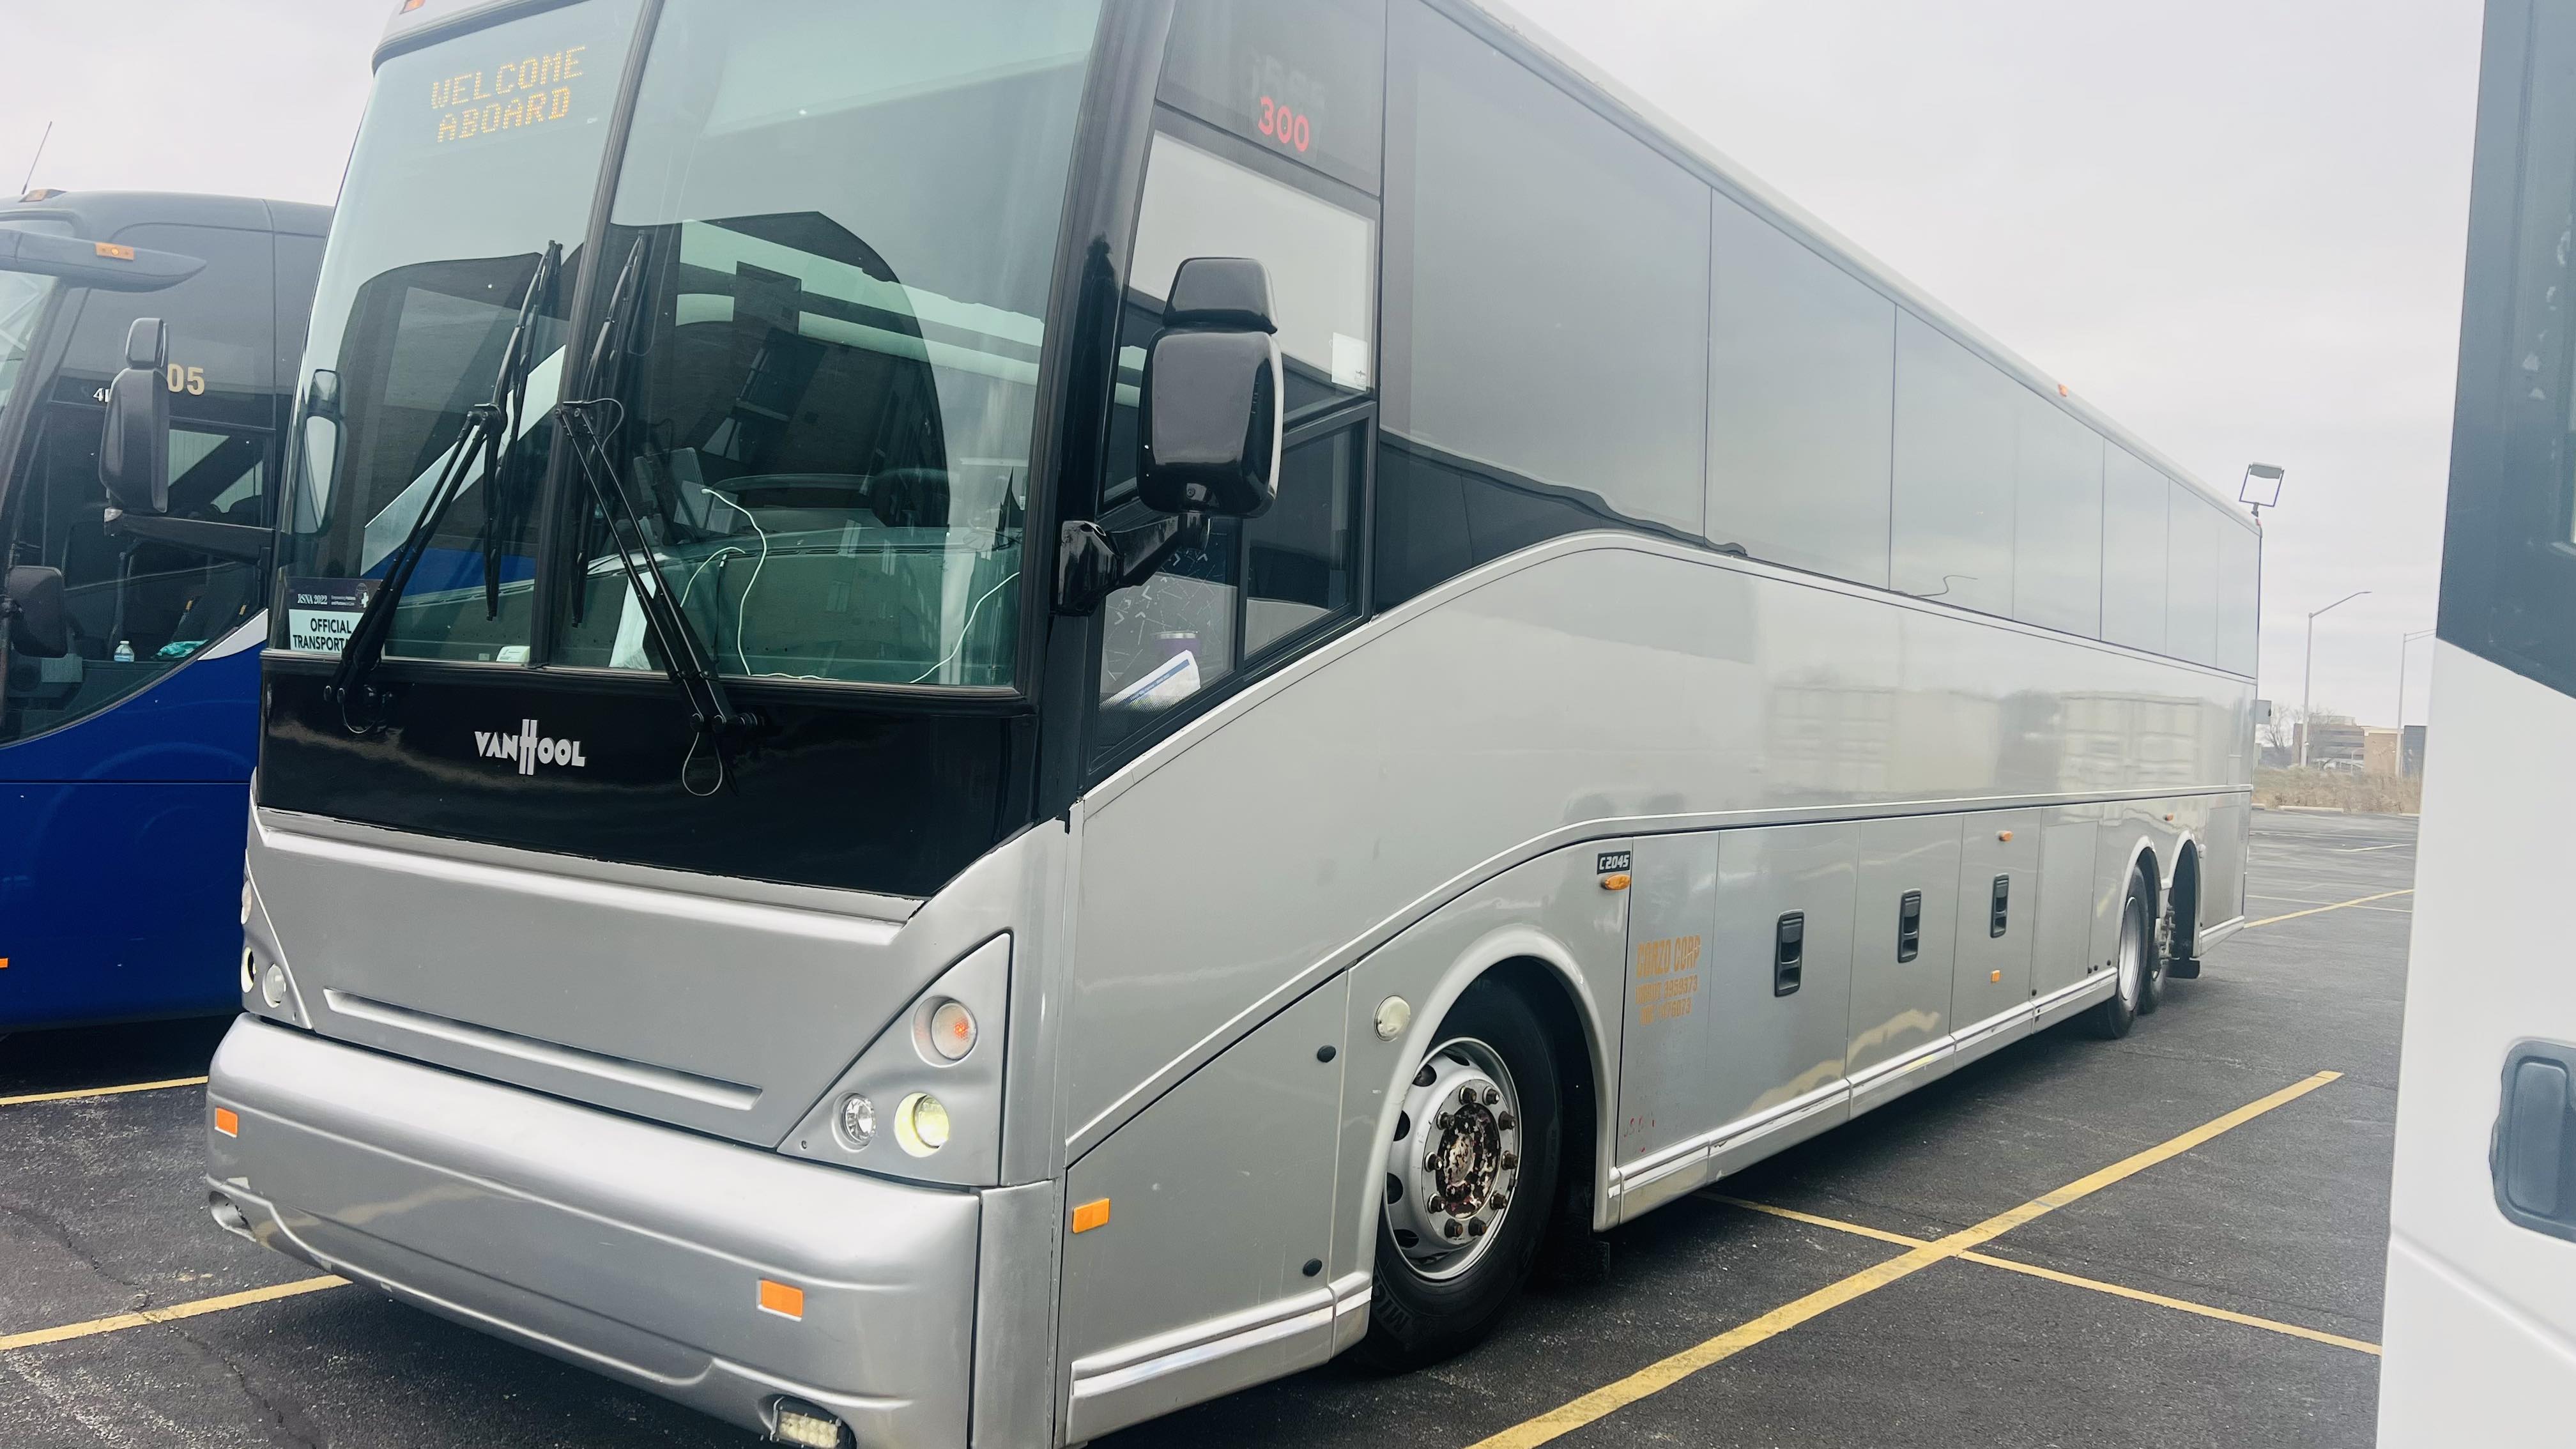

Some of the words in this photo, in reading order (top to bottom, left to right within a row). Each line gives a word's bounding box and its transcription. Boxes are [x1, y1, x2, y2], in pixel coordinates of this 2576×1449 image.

[431, 45, 585, 109] WELCOME
[437, 86, 570, 142] ABOARD
[1258, 96, 1310, 152] 300
[293, 634, 349, 652] TRANSPORT
[310, 618, 352, 634] OFFICIAL
[1598, 854, 1630, 871] C2045
[1674, 934, 1701, 972] CORP
